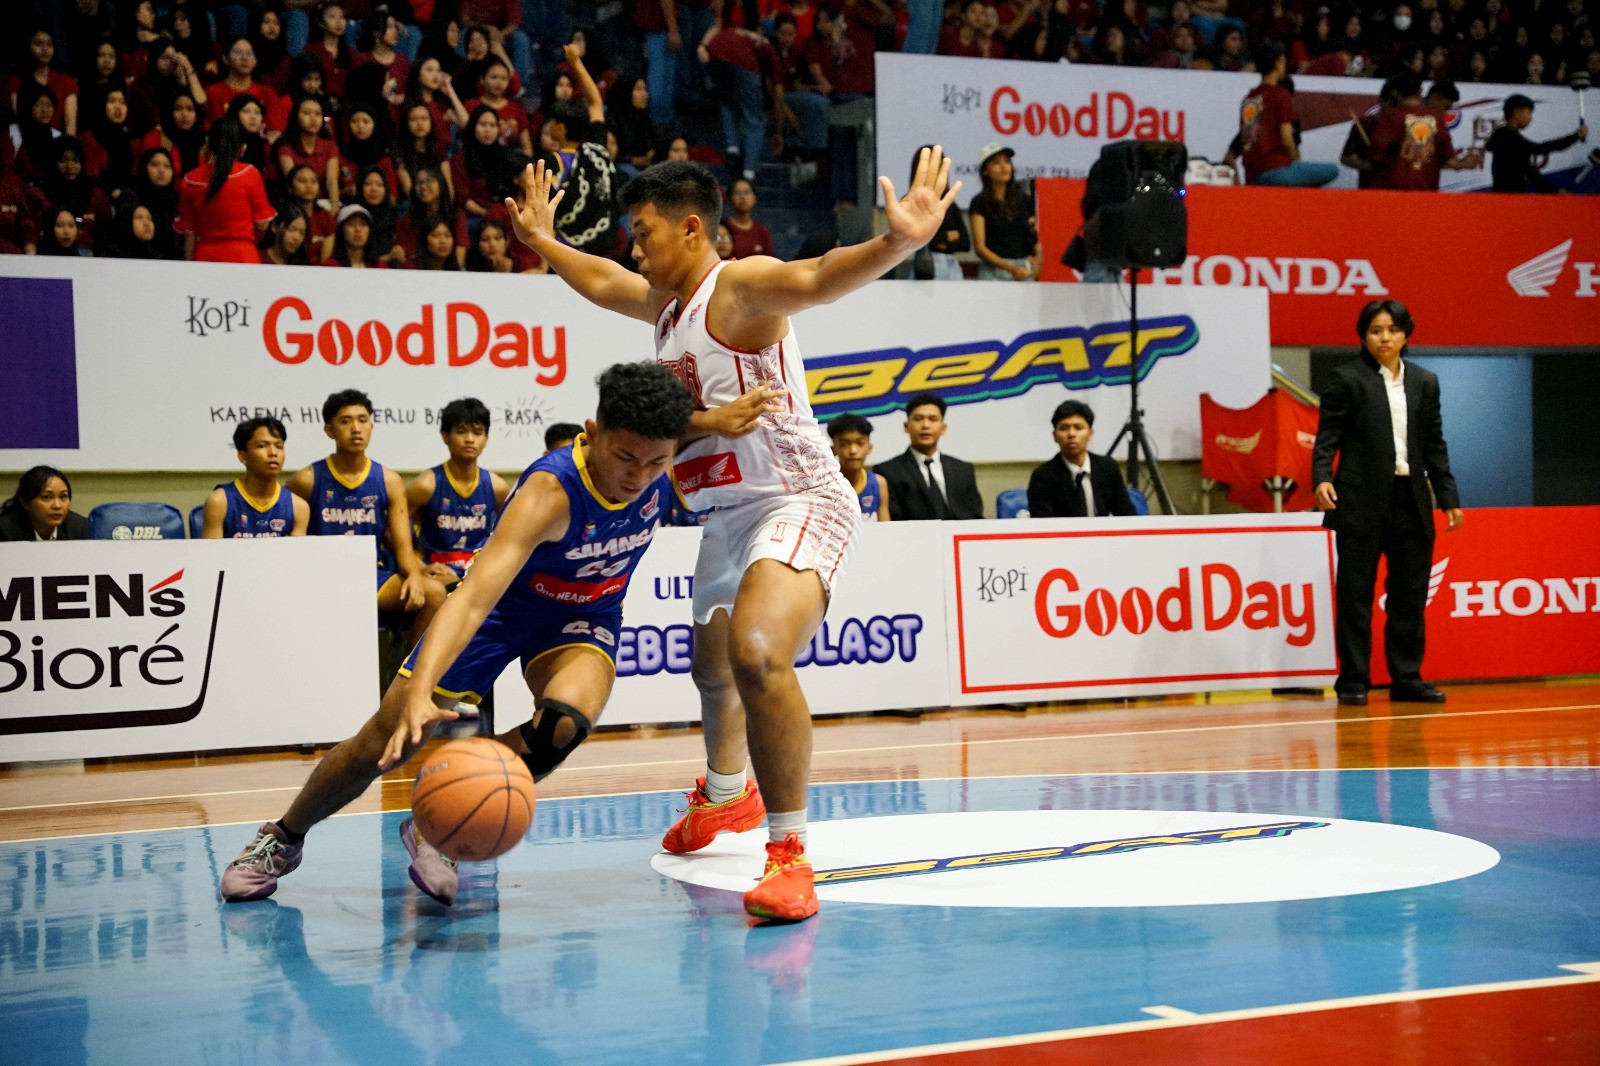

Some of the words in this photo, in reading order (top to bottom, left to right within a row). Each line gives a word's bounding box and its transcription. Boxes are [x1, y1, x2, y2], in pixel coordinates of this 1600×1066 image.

[262, 296, 436, 366] Good
[446, 302, 567, 387] Day
[373, 408, 416, 424] ERLU
[505, 409, 544, 425] RASA
[132, 526, 163, 539] DBL
[1034, 567, 1193, 639] Good
[1201, 563, 1317, 647] Day
[1449, 577, 1600, 618] HON
